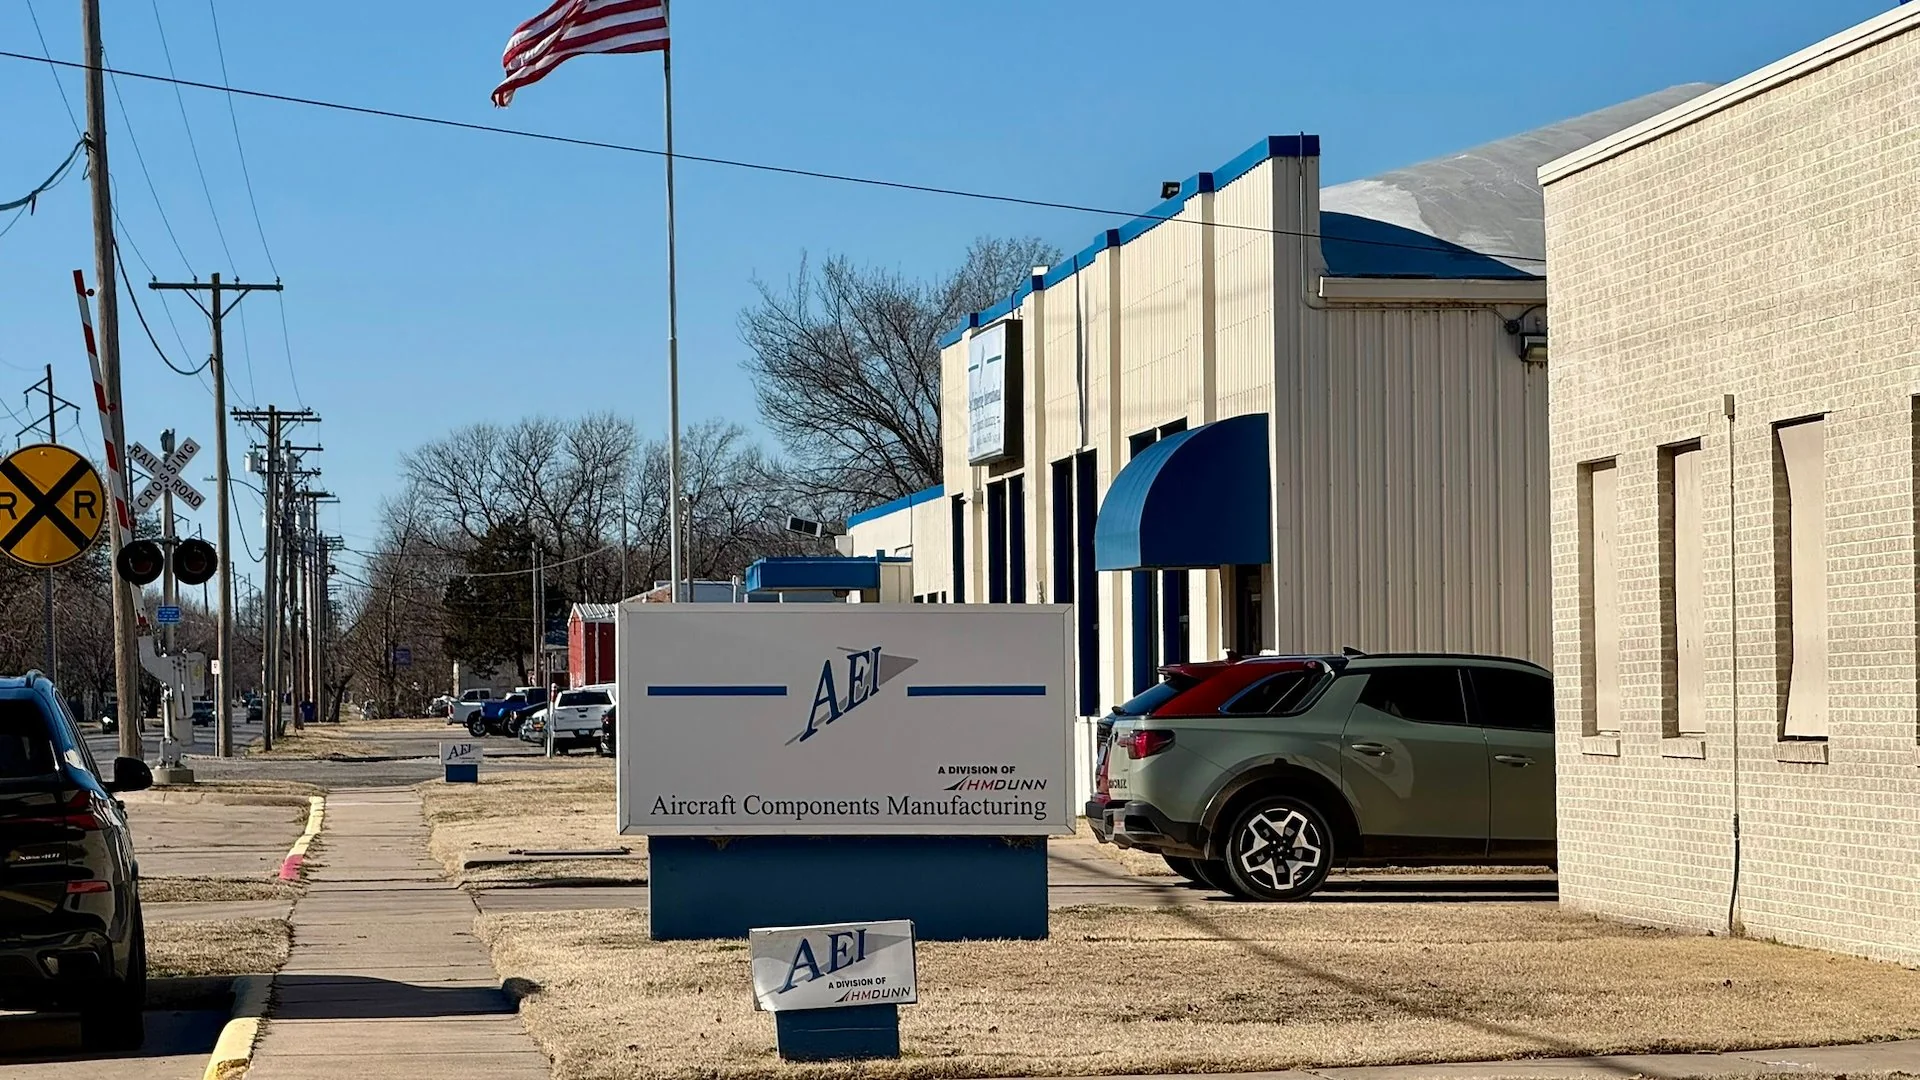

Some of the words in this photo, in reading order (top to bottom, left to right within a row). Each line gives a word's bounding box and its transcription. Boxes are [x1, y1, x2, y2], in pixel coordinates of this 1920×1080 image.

[130, 446, 157, 473] RAIL
[171, 480, 203, 508] ROAD
[137, 443, 195, 509] CROSSING
[74, 491, 97, 519] R
[799, 646, 882, 742] AEI
[937, 766, 946, 774] A
[948, 766, 998, 774] DIVISION
[1001, 765, 1016, 774] OF
[966, 779, 1048, 791] HMDUNN
[650, 795, 736, 815] Aircraft
[743, 796, 880, 820] Components
[886, 795, 1048, 820] Manufacturing
[777, 928, 867, 994] AEI
[828, 981, 834, 989] A
[836, 977, 873, 989] DIVISION
[875, 976, 887, 985] OF
[850, 986, 911, 1001] HMDUNN
